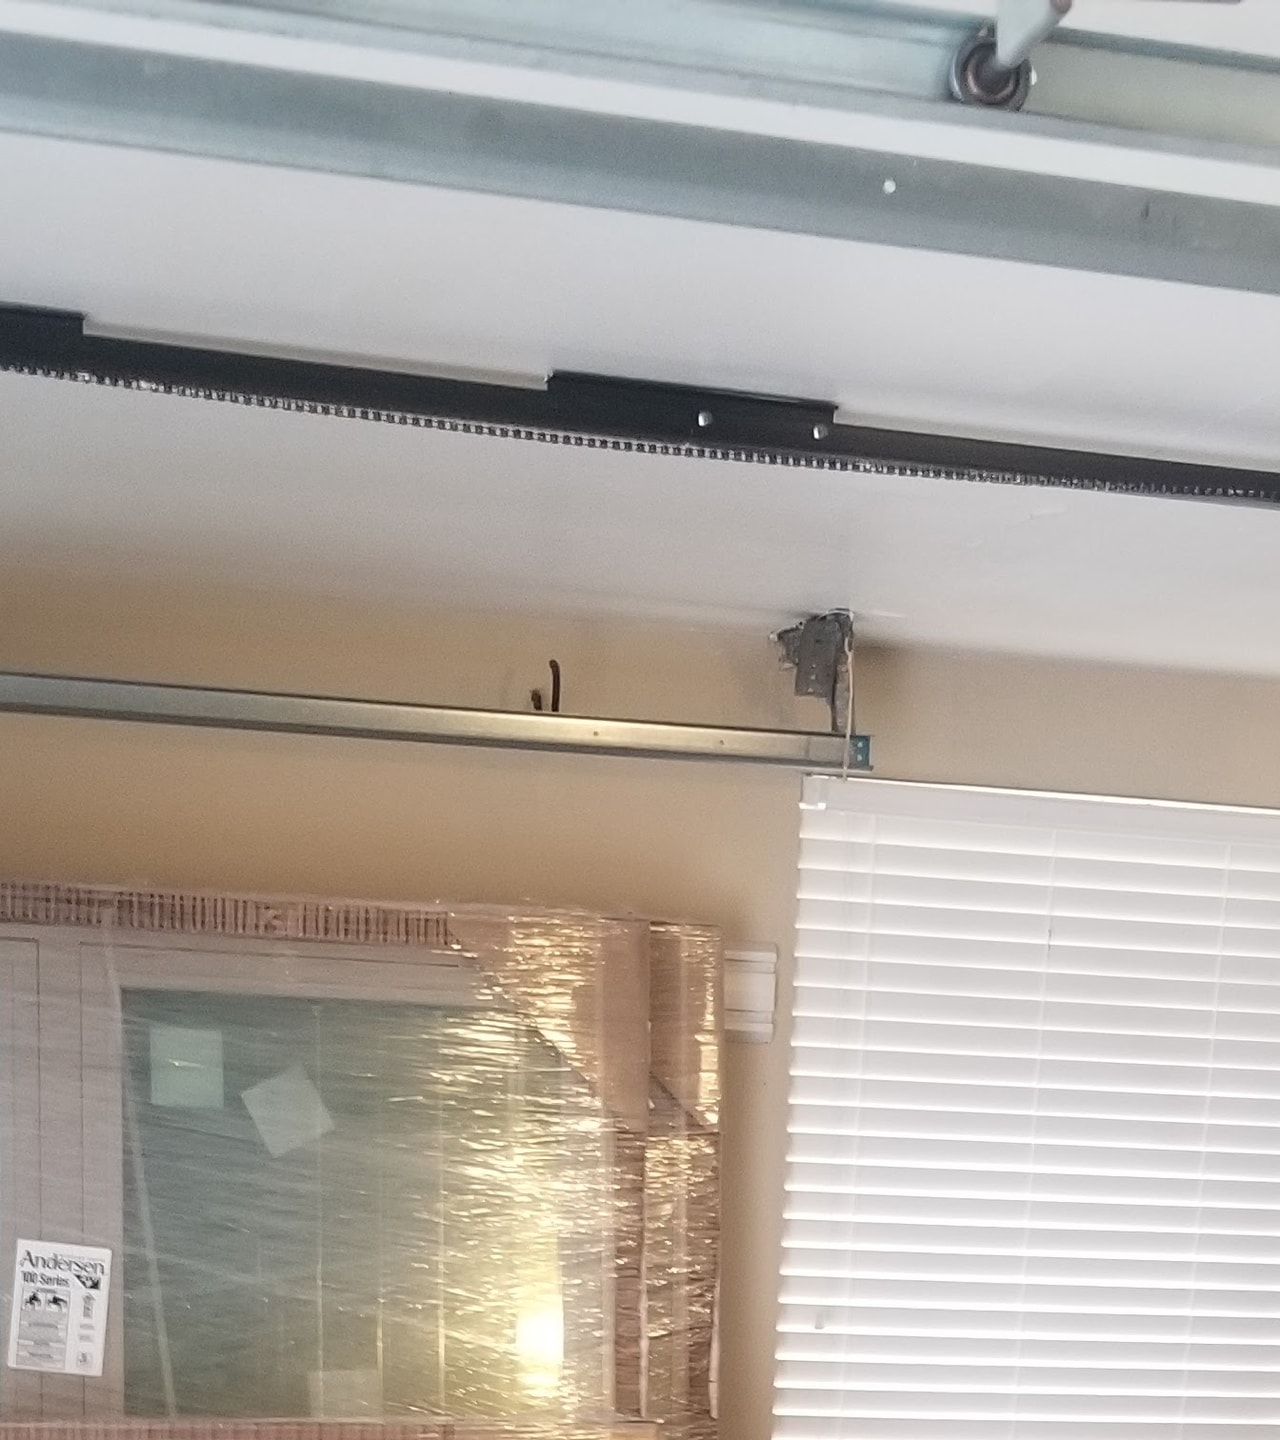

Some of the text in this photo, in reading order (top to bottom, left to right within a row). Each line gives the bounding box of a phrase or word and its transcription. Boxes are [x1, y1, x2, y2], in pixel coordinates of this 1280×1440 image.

[20, 1249, 105, 1276] Andersen
[21, 1270, 39, 1284] 100
[39, 1272, 70, 1288] Series
